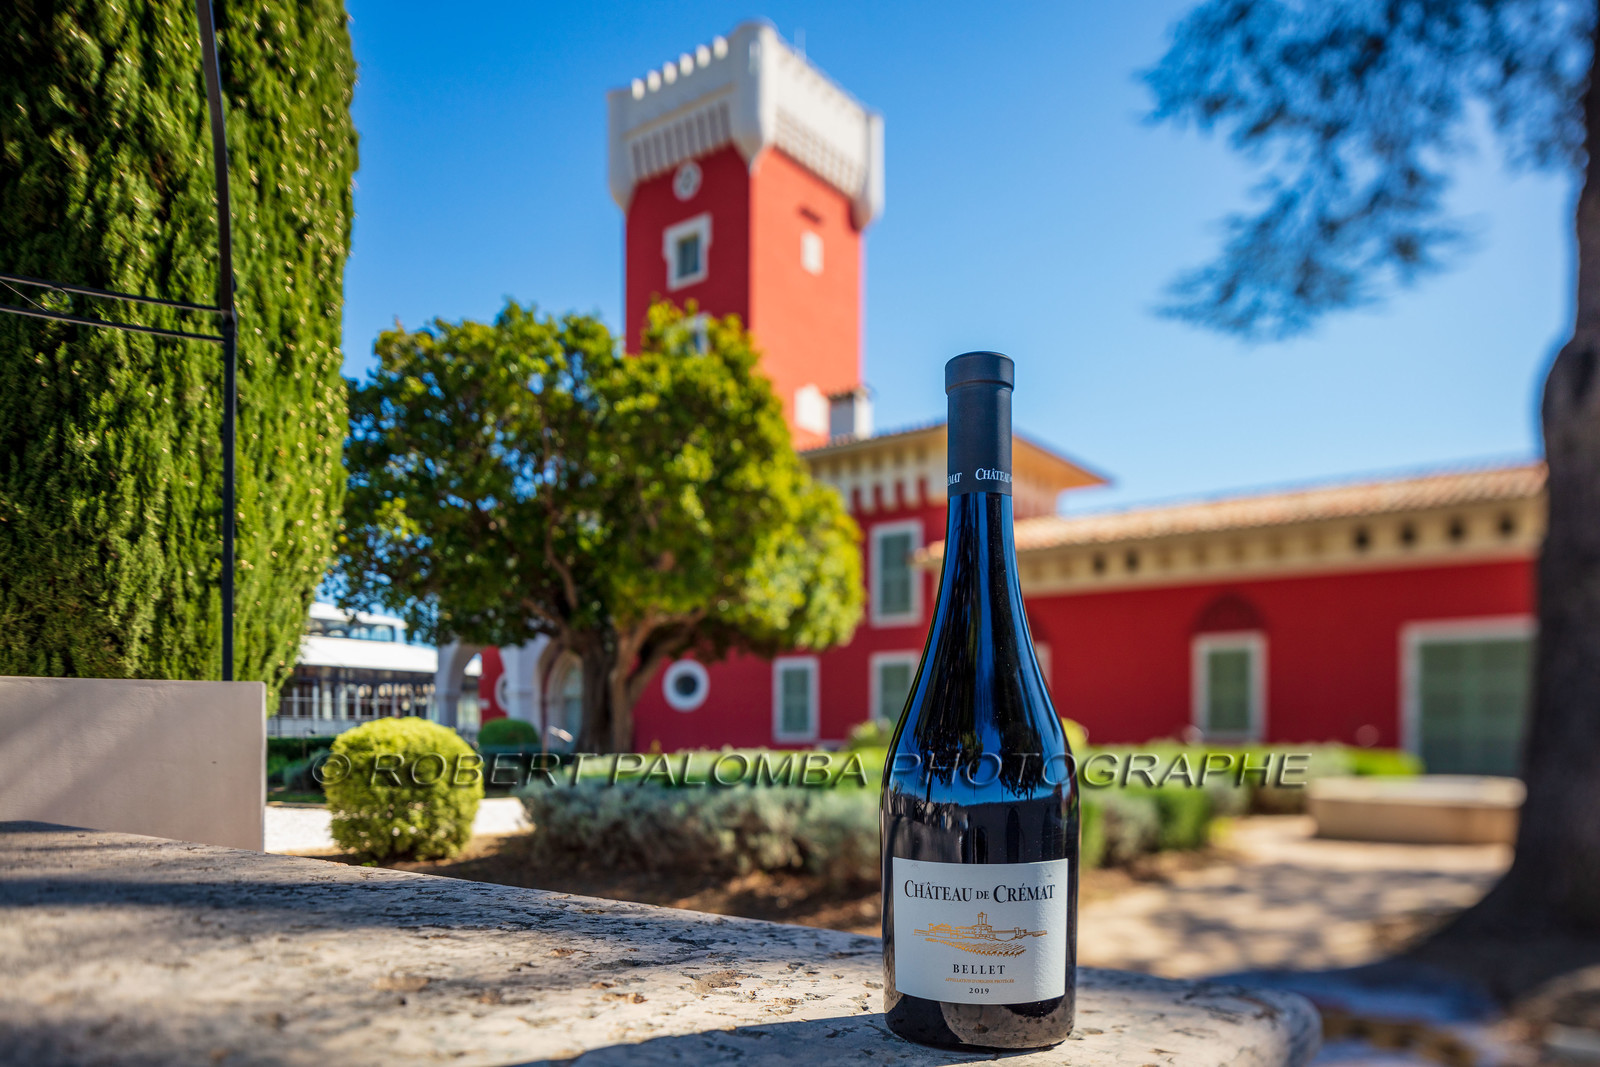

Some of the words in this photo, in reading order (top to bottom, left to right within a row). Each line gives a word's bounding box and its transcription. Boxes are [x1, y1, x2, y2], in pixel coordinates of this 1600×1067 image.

[904, 879, 972, 902] CHÂTEAU
[975, 890, 990, 900] DE
[993, 882, 1056, 904] CRÉMAT
[952, 963, 1006, 975] BELLET
[968, 987, 990, 995] 2019
